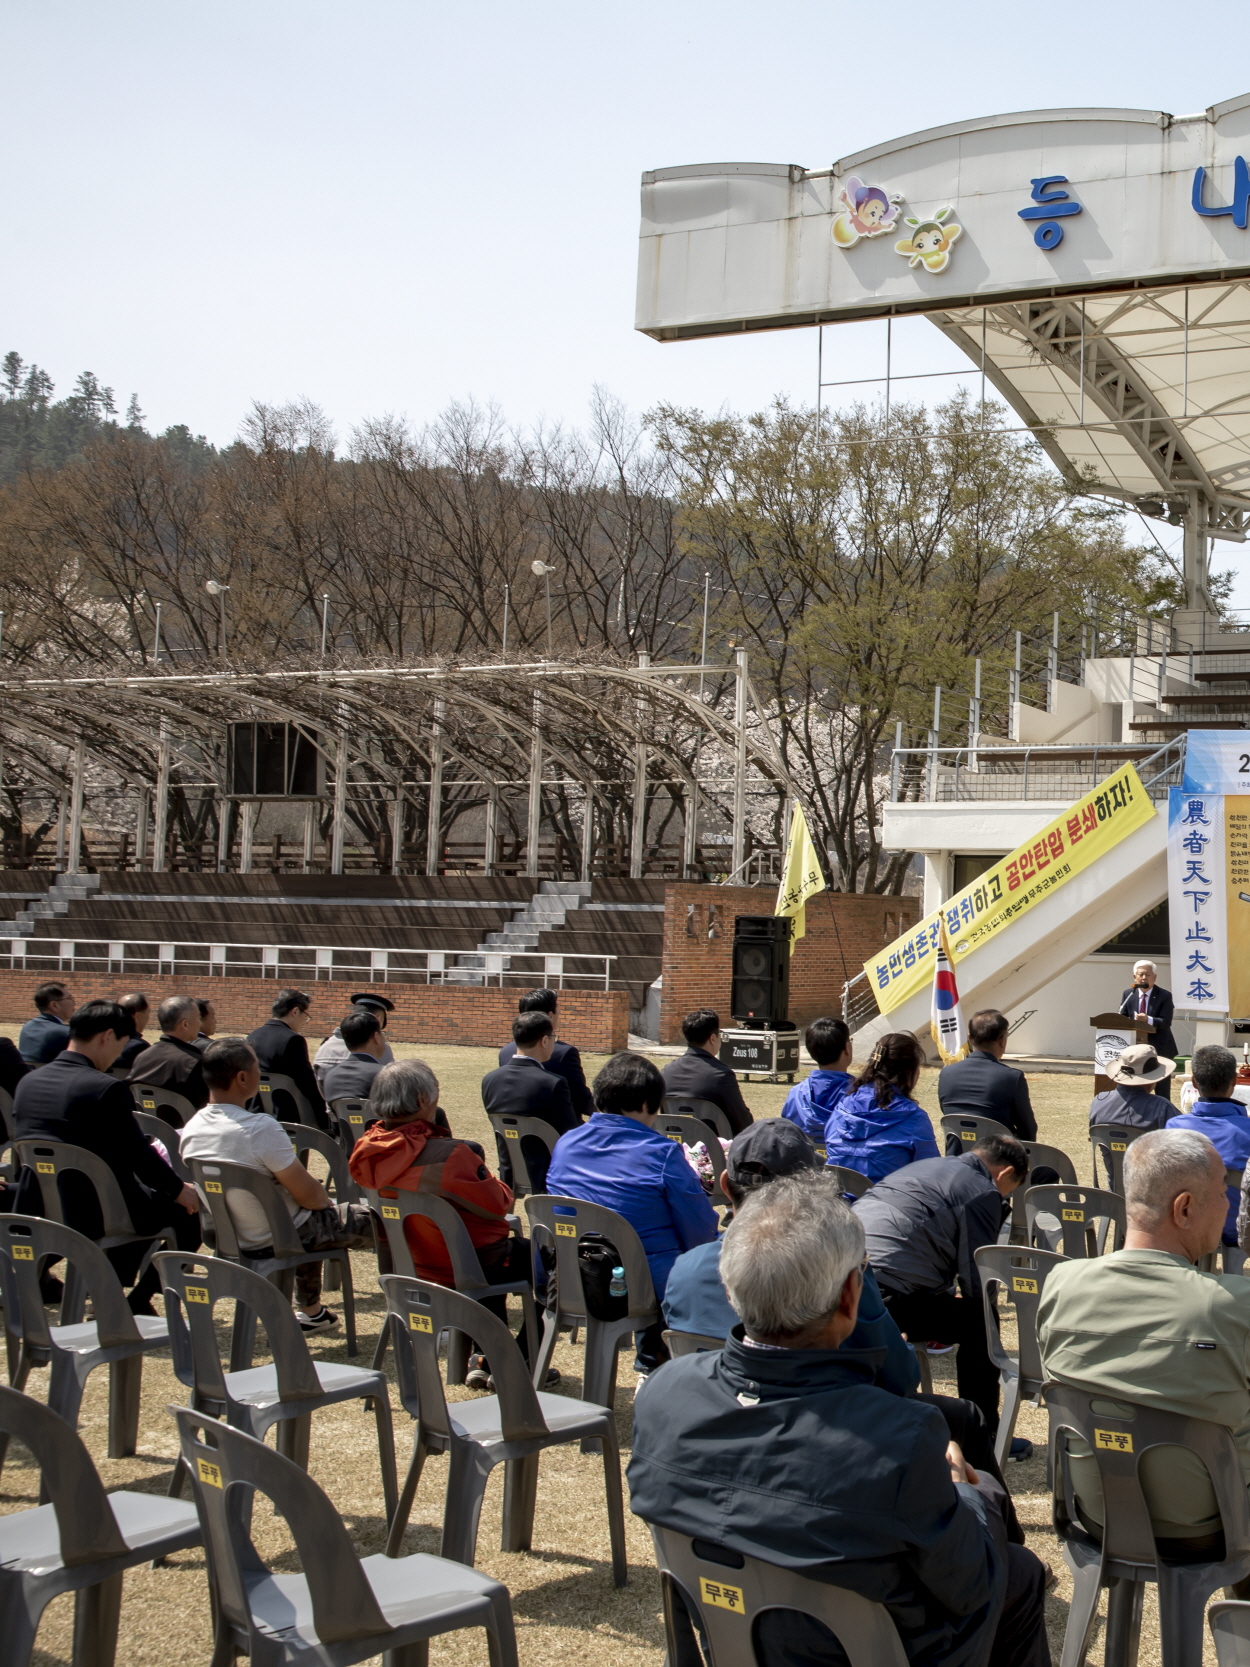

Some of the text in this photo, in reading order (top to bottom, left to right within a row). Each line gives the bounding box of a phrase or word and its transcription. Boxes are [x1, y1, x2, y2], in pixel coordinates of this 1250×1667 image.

[946, 873, 1004, 937] 쟁취하고
[1005, 827, 1066, 892] 공안탄압
[1067, 775, 1134, 846] 분쇄하자!
[733, 1046, 747, 1058] Zeus
[383, 1207, 398, 1218] 무풍
[1064, 1210, 1082, 1220] 무풍
[557, 1224, 574, 1236] 무풍
[14, 1247, 31, 1259] 무풍
[1015, 1279, 1035, 1292] 무풍
[188, 1288, 206, 1301] 무풍
[412, 1315, 430, 1330] 무풍
[1099, 1432, 1129, 1449] 무풍
[200, 1463, 219, 1483] 무풍
[705, 1582, 740, 1608] 무풍
